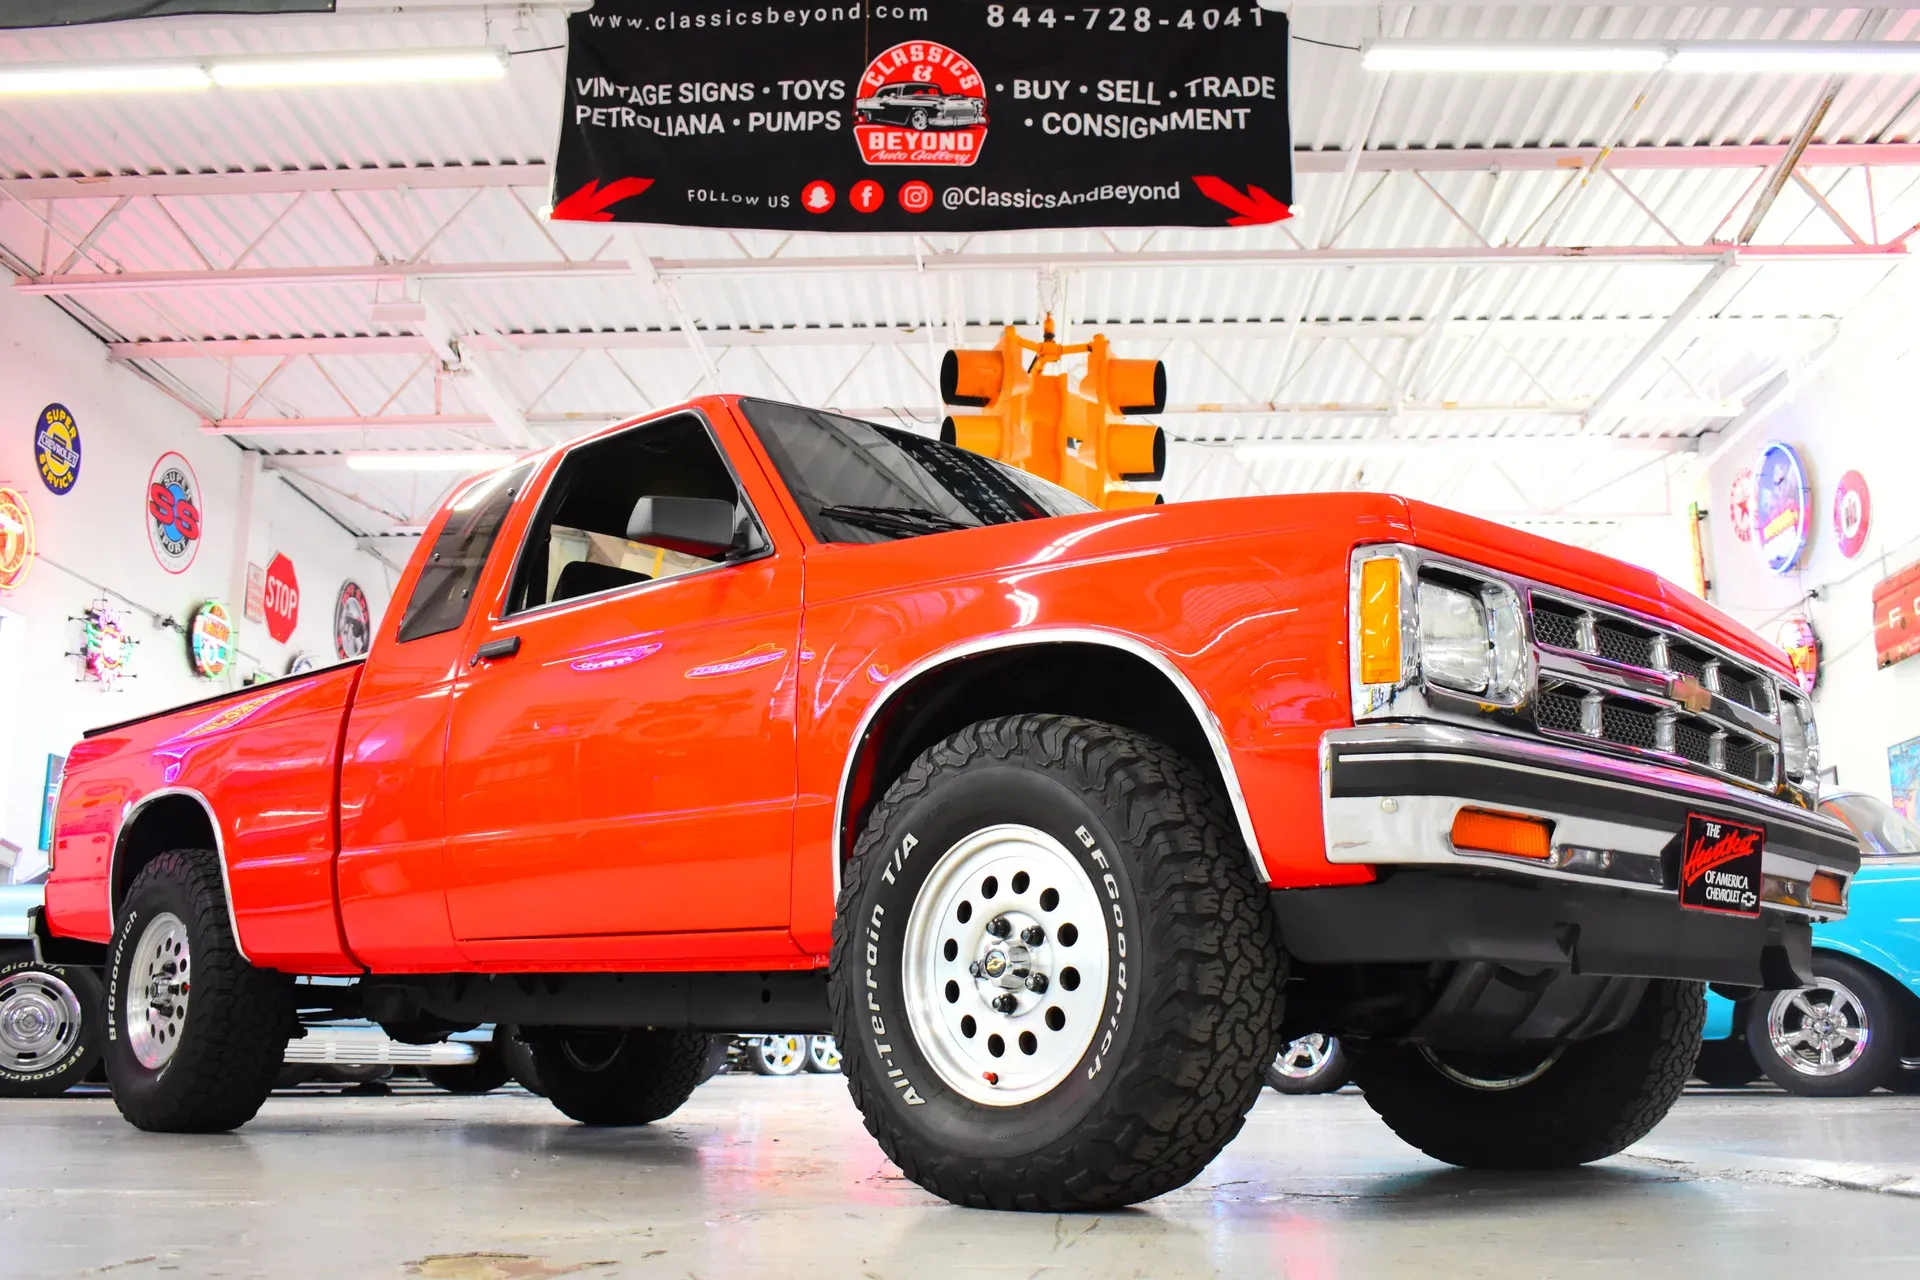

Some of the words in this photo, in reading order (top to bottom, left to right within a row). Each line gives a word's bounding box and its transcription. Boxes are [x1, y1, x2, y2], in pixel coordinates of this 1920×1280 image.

[590, 3, 928, 31] www.classicsbeyond.com
[987, 4, 1262, 32] 844-728-4041
[865, 44, 979, 90] CLASSICS
[912, 65, 933, 82] &
[576, 77, 672, 106] VINTAGE
[679, 82, 754, 103] SIGNS
[778, 80, 845, 100] TOYS
[1013, 79, 1070, 100] BUY
[1097, 80, 1161, 105] SELL
[1185, 76, 1276, 99] TRADE
[576, 105, 725, 136] PETROLIANA
[748, 111, 841, 132] PUMPS
[1042, 108, 1251, 139] CONSIGNMENT
[869, 132, 973, 150] BEYOND
[870, 149, 908, 160] Auto
[910, 149, 971, 166] Gallery
[687, 189, 759, 205] FOLLOW
[768, 195, 790, 208] US
[942, 182, 1180, 209] @ClassicsAndBeyond
[46, 408, 77, 439] SUPER
[41, 436, 77, 464] CHEVROLET
[39, 453, 74, 489] SERVICE
[150, 482, 199, 540] SS
[265, 575, 298, 620] STOP
[1706, 822, 1721, 838] THE
[881, 833, 919, 886] T/A
[1705, 869, 1716, 884] OF
[1715, 872, 1749, 890] AMERICA
[1706, 886, 1741, 903] CHEVROLET
[1, 960, 35, 974] dial
[1075, 825, 1127, 1080] BFGoodrich
[108, 911, 138, 1041] BFGoodrich
[866, 903, 926, 1105] All-Terrain
[0, 1045, 85, 1081] BFGoodric
